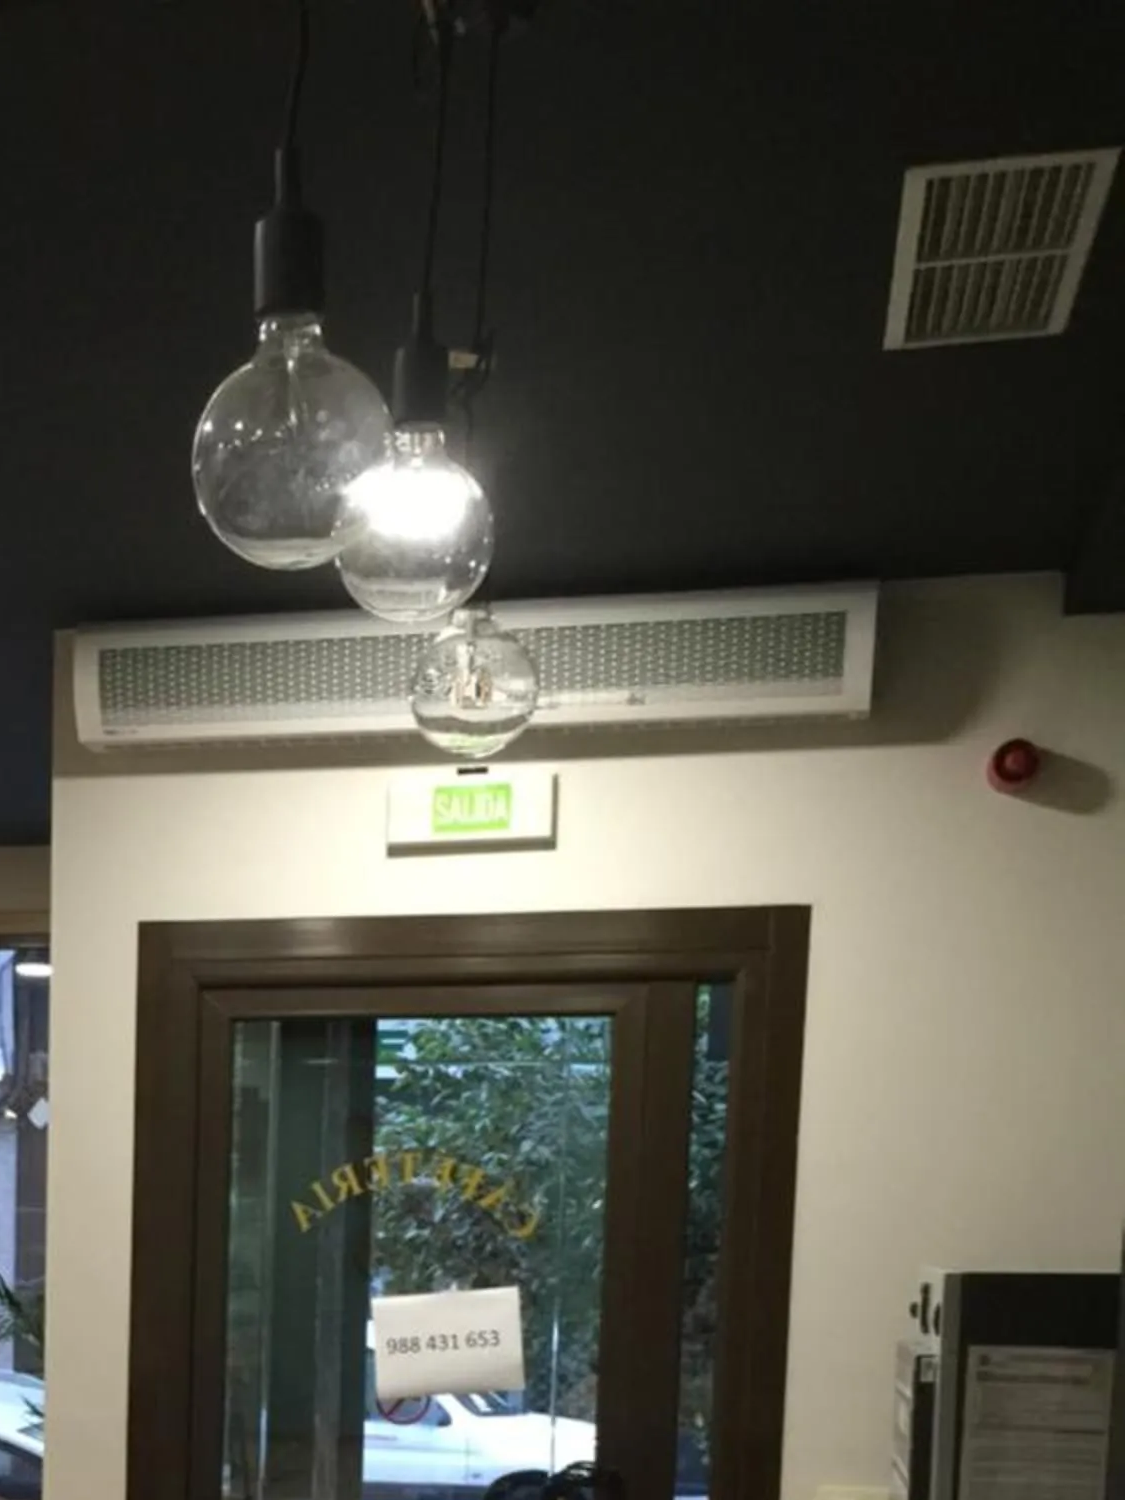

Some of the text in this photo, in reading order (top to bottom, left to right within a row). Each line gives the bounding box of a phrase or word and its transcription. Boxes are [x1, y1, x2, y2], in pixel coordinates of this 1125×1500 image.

[435, 790, 508, 824] SALIDA
[386, 1329, 501, 1355] 988 431 653
